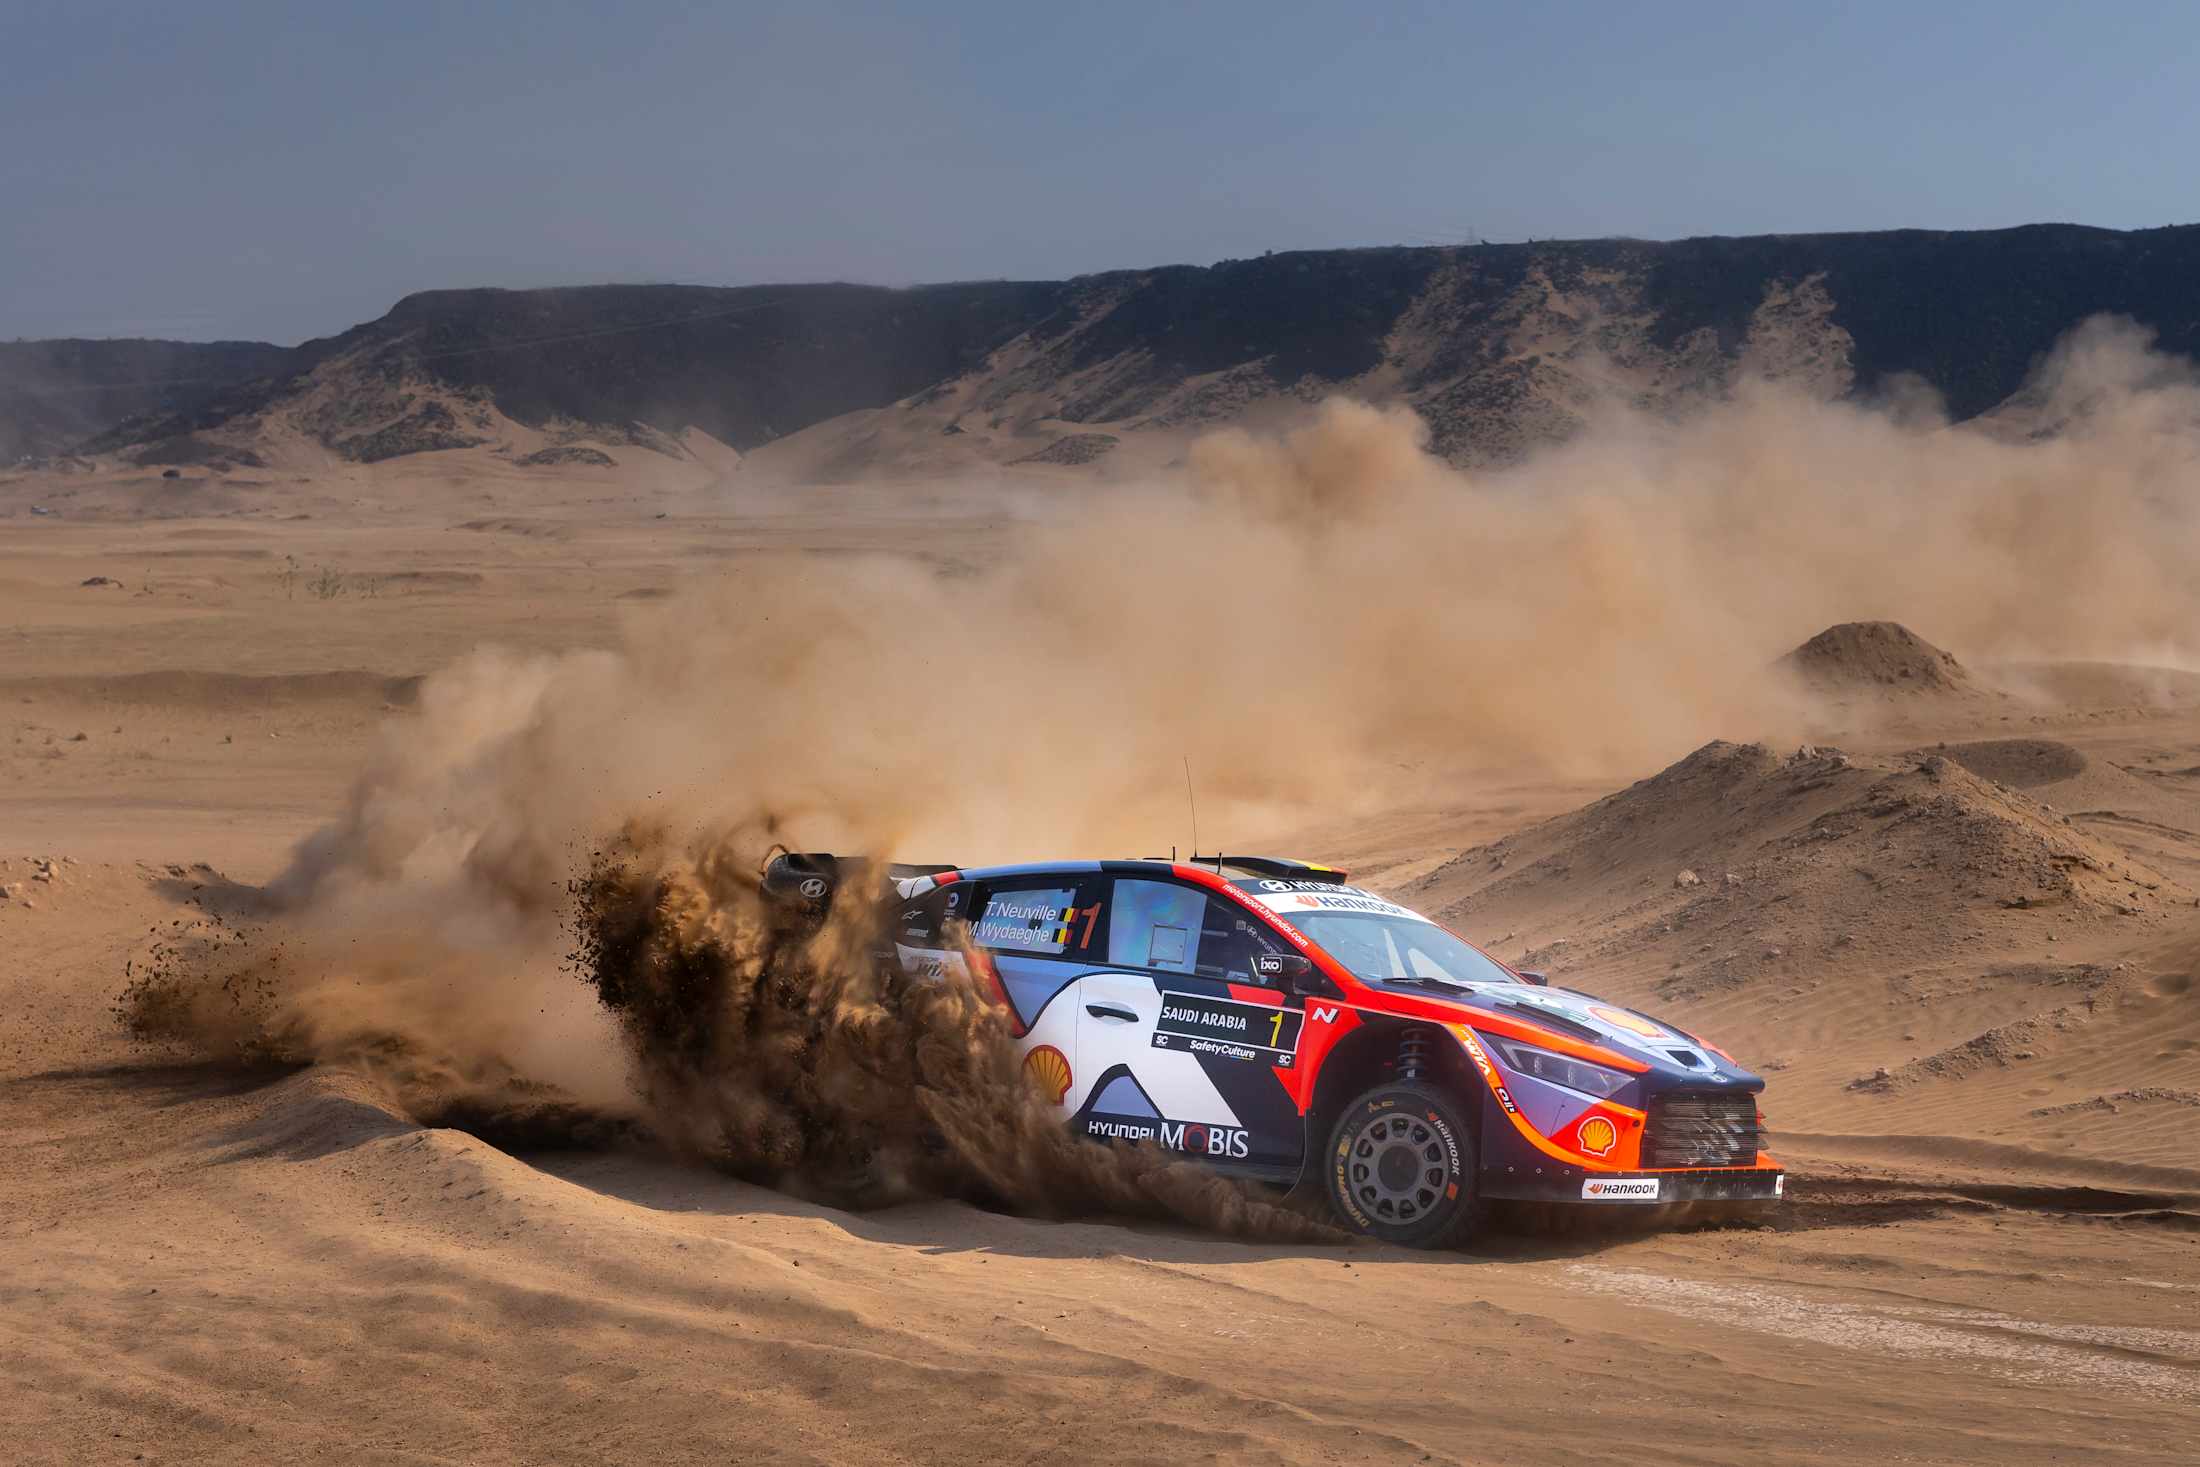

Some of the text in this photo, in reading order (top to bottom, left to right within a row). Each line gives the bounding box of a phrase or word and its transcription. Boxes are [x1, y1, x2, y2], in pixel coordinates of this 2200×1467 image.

[996, 902, 1056, 921] Neuville
[1222, 884, 1308, 947] motorsport.hyundai.com
[982, 921, 1049, 944] Wydaeghe
[1080, 902, 1102, 949] 1
[1161, 1006, 1247, 1031] SAUDI ARABIA
[1269, 1011, 1284, 1048] 1
[1155, 1035, 1168, 1045] SC
[1189, 1039, 1256, 1060] SafetyCulture
[1278, 1055, 1291, 1064] SC
[1088, 1120, 1249, 1158] HYUNDAI MOBIS
